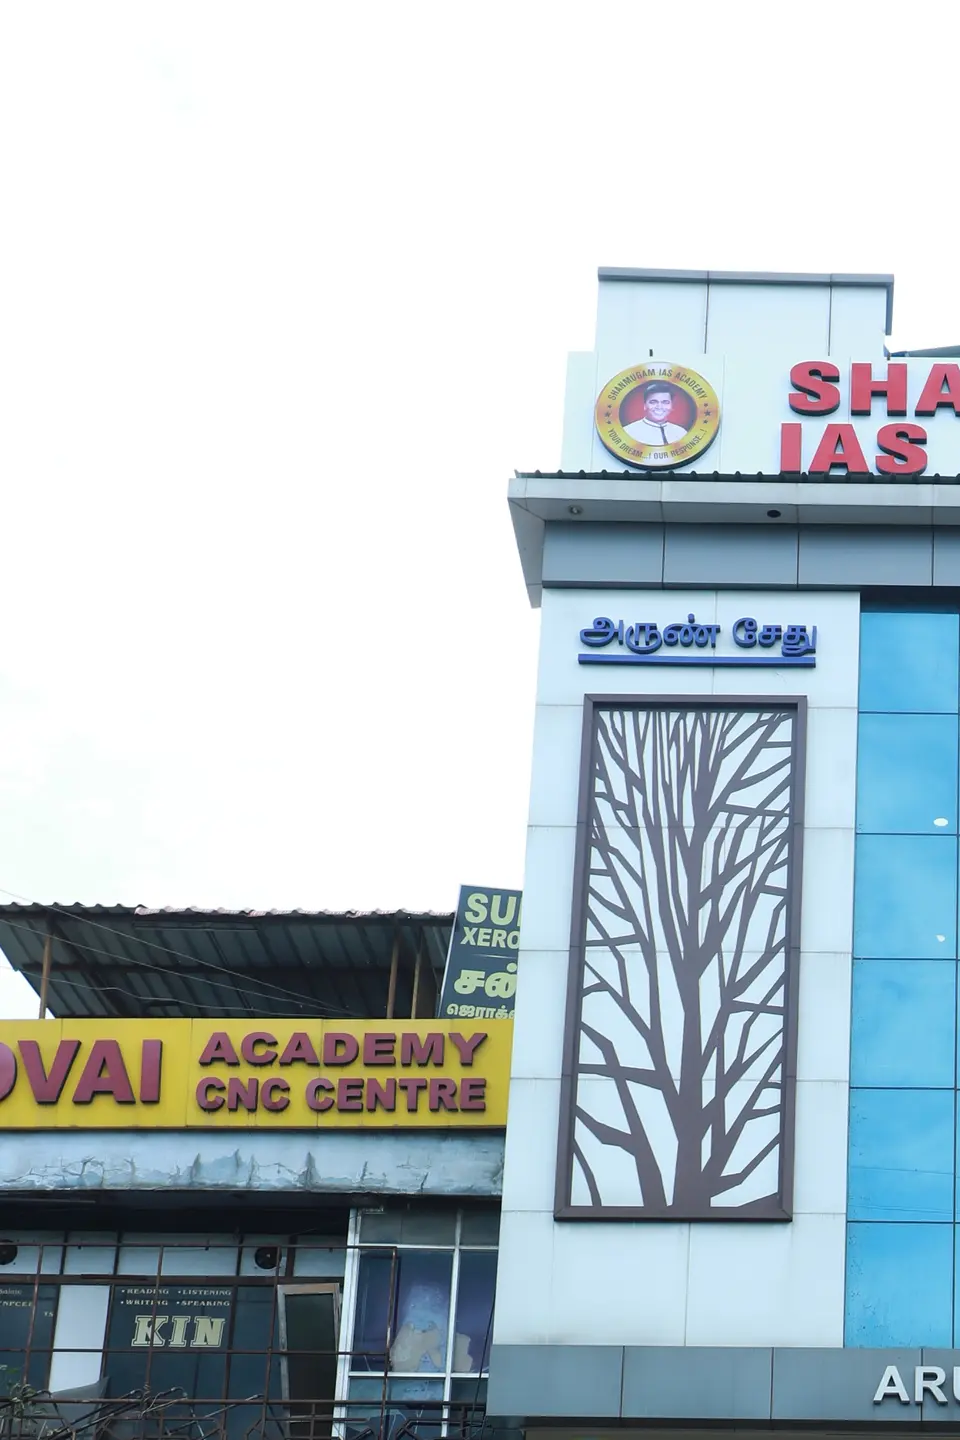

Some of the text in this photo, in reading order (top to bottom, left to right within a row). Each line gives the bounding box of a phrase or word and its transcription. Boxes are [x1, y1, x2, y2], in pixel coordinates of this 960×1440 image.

[608, 369, 708, 401] SHANMUGAM IAS ACADEMY
[780, 422, 929, 478] IAS
[580, 613, 817, 657] அருண் சேது
[199, 1031, 488, 1067] ACADEMY
[195, 1077, 487, 1112] CNC CENTRE
